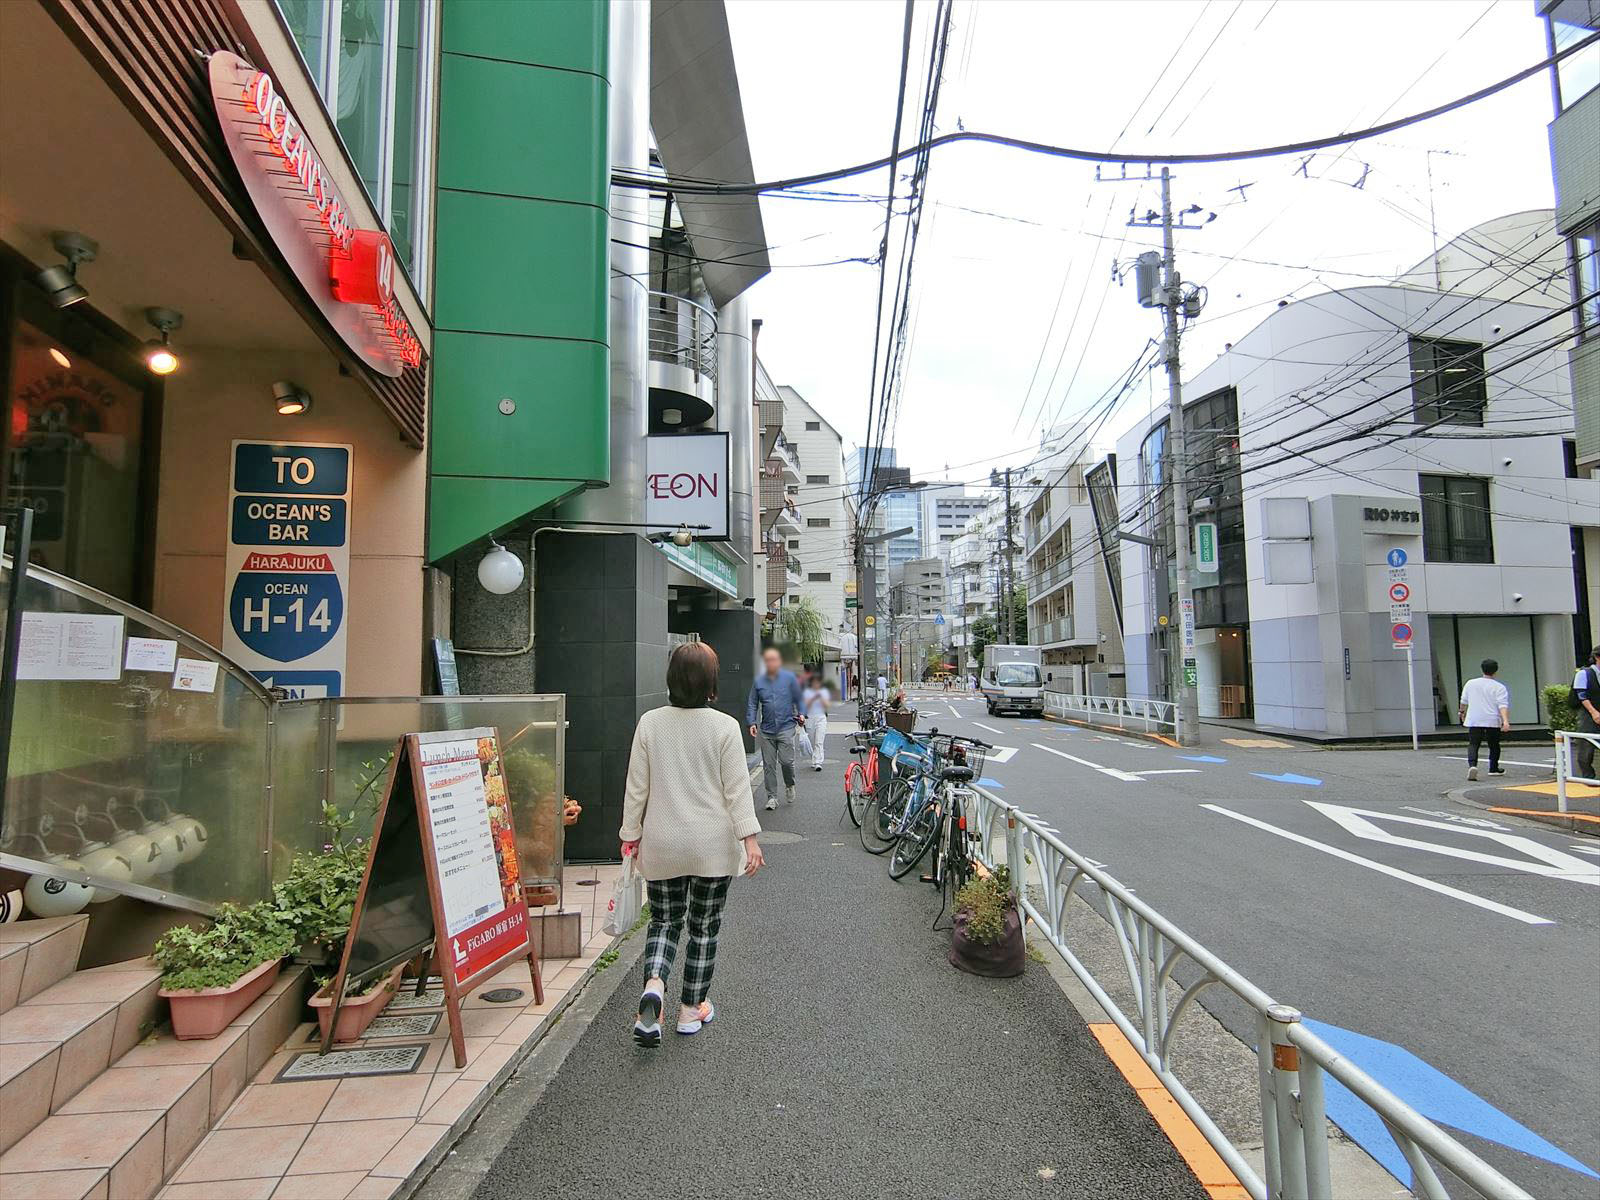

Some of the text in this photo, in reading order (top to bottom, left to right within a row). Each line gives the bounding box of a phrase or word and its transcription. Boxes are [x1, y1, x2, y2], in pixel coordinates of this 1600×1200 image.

[379, 244, 392, 297] 14
[271, 456, 316, 485] TO
[647, 472, 718, 499] EON
[247, 502, 332, 521] OCEAN'S
[1364, 507, 1390, 522] RIO
[268, 523, 309, 541] BAR
[250, 556, 326, 570] HARAJUKU
[264, 583, 308, 595] OCEAN
[243, 597, 332, 633] H-14
[423, 746, 451, 763] Lunch
[453, 747, 475, 760] Menu
[508, 912, 523, 929] H-14
